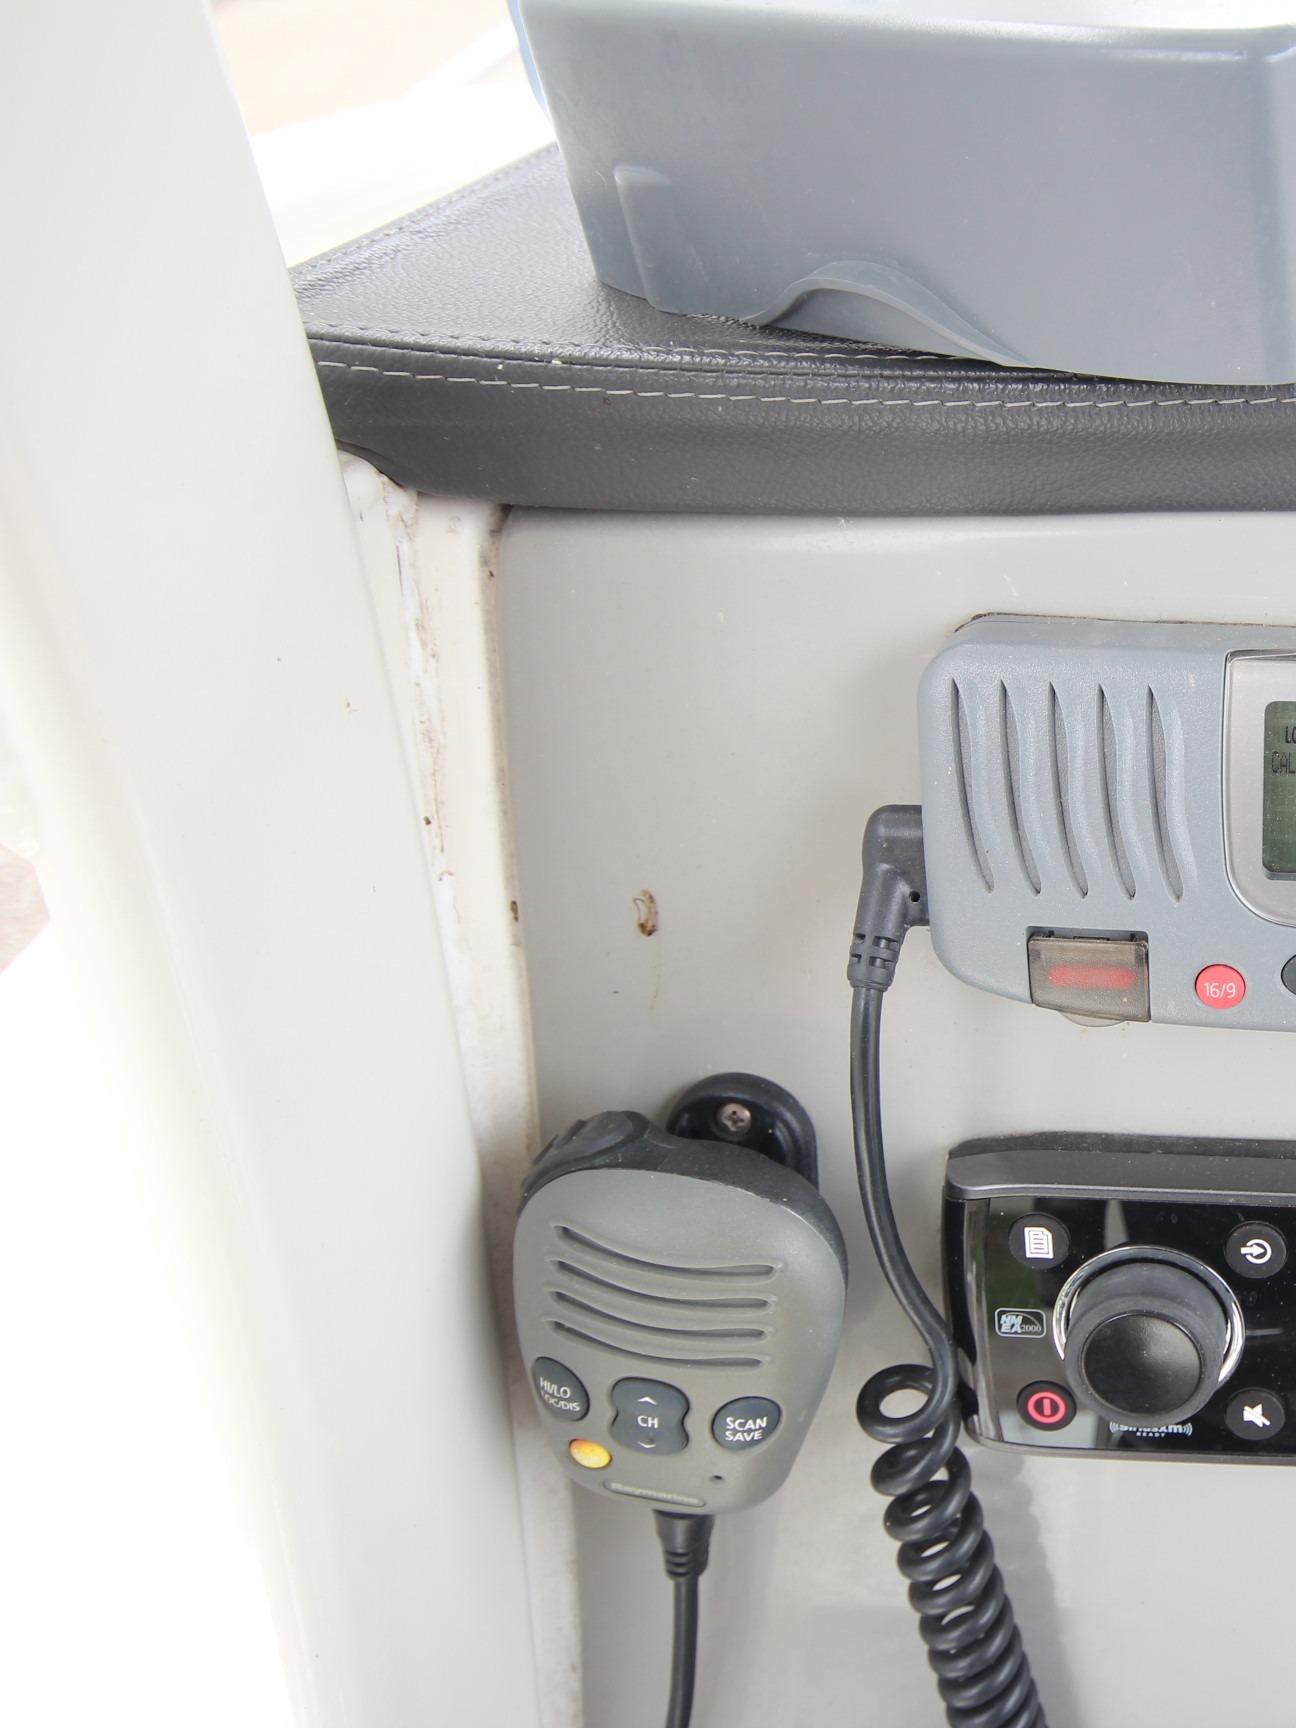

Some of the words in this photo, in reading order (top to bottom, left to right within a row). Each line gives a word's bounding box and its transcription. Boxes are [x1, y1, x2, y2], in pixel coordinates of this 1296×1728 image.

[1203, 980, 1237, 999] 16/9
[540, 1376, 571, 1398] HI/LO
[637, 1415, 659, 1429] CH
[726, 1415, 768, 1432] SCAN
[725, 1430, 763, 1442] SAVE
